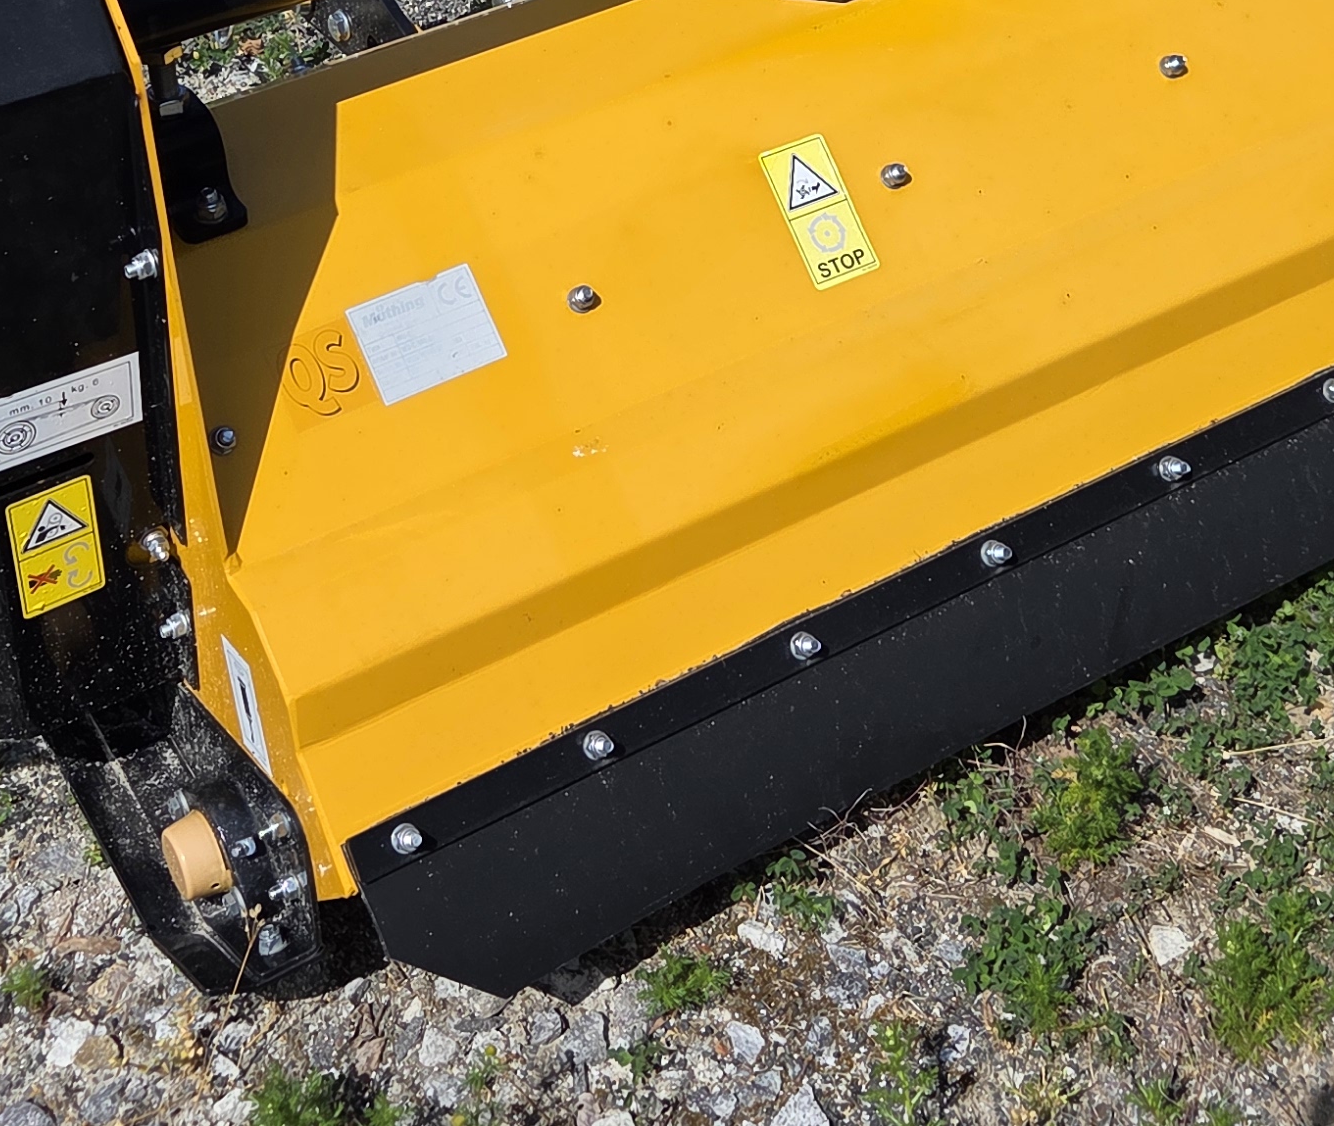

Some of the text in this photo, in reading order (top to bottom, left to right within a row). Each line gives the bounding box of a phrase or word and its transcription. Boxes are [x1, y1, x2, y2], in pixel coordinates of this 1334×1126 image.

[817, 248, 865, 278] STOP
[361, 295, 425, 328] Müthing
[277, 329, 360, 416] QS
[39, 396, 52, 406] 10
